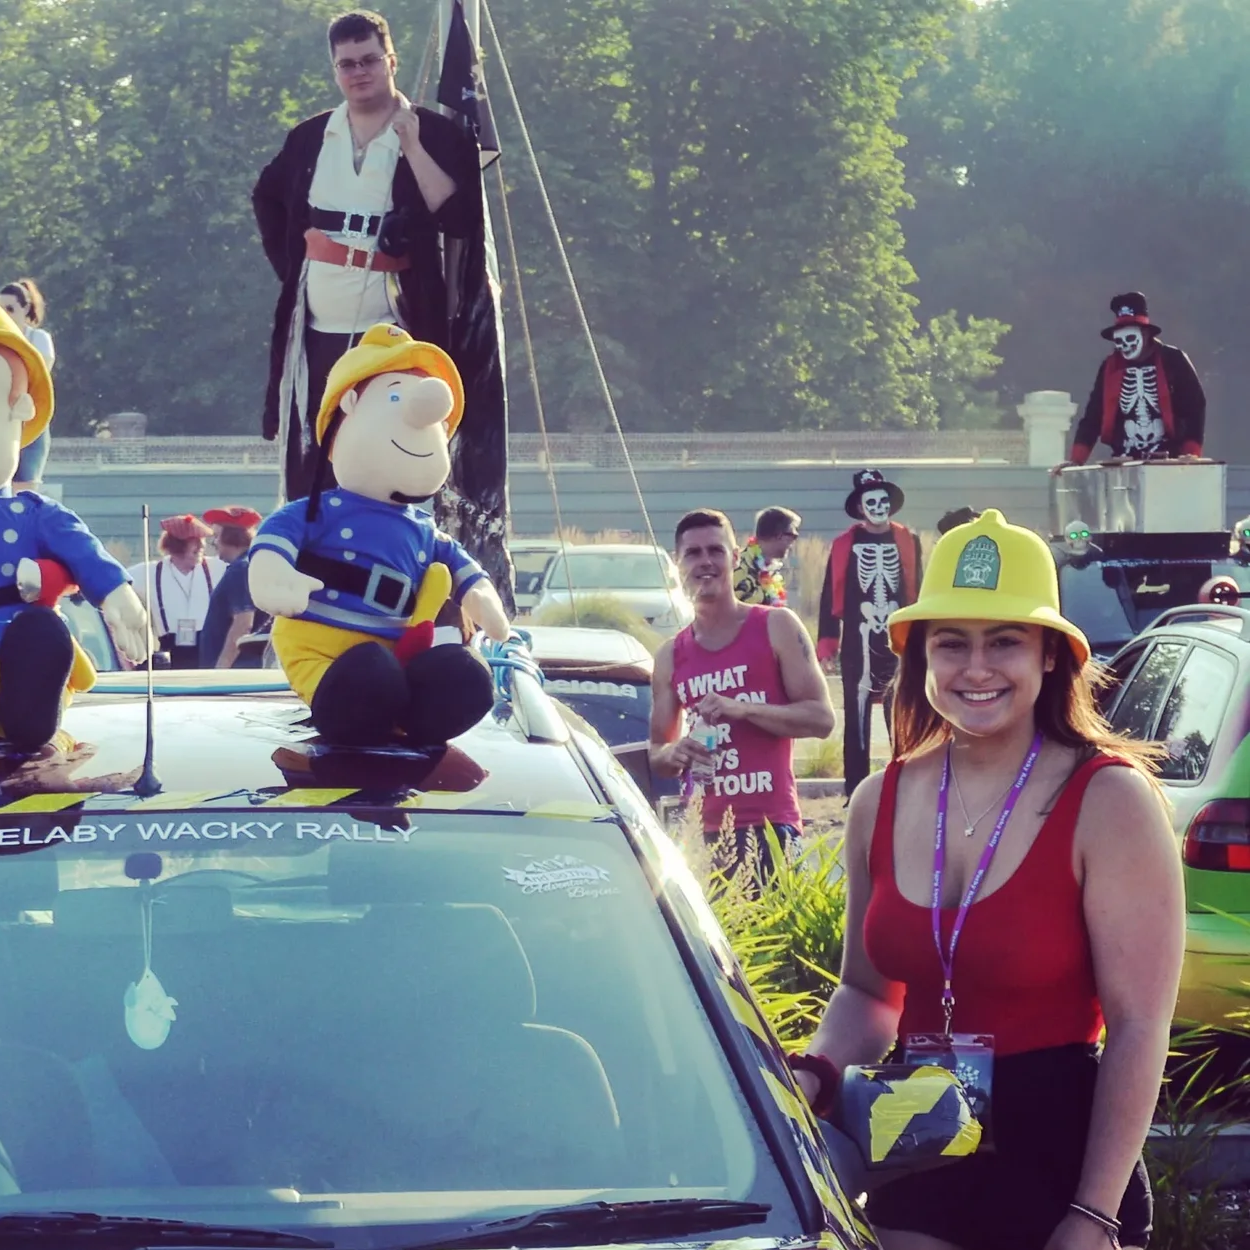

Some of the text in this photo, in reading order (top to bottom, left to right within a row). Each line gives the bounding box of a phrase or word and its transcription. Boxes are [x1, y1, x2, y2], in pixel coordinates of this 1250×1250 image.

[968, 543, 996, 553] FIRE
[964, 553, 996, 563] CHIEF
[712, 771, 773, 797] TOUR
[137, 822, 283, 840] WACKY
[295, 822, 420, 843] RALLY
